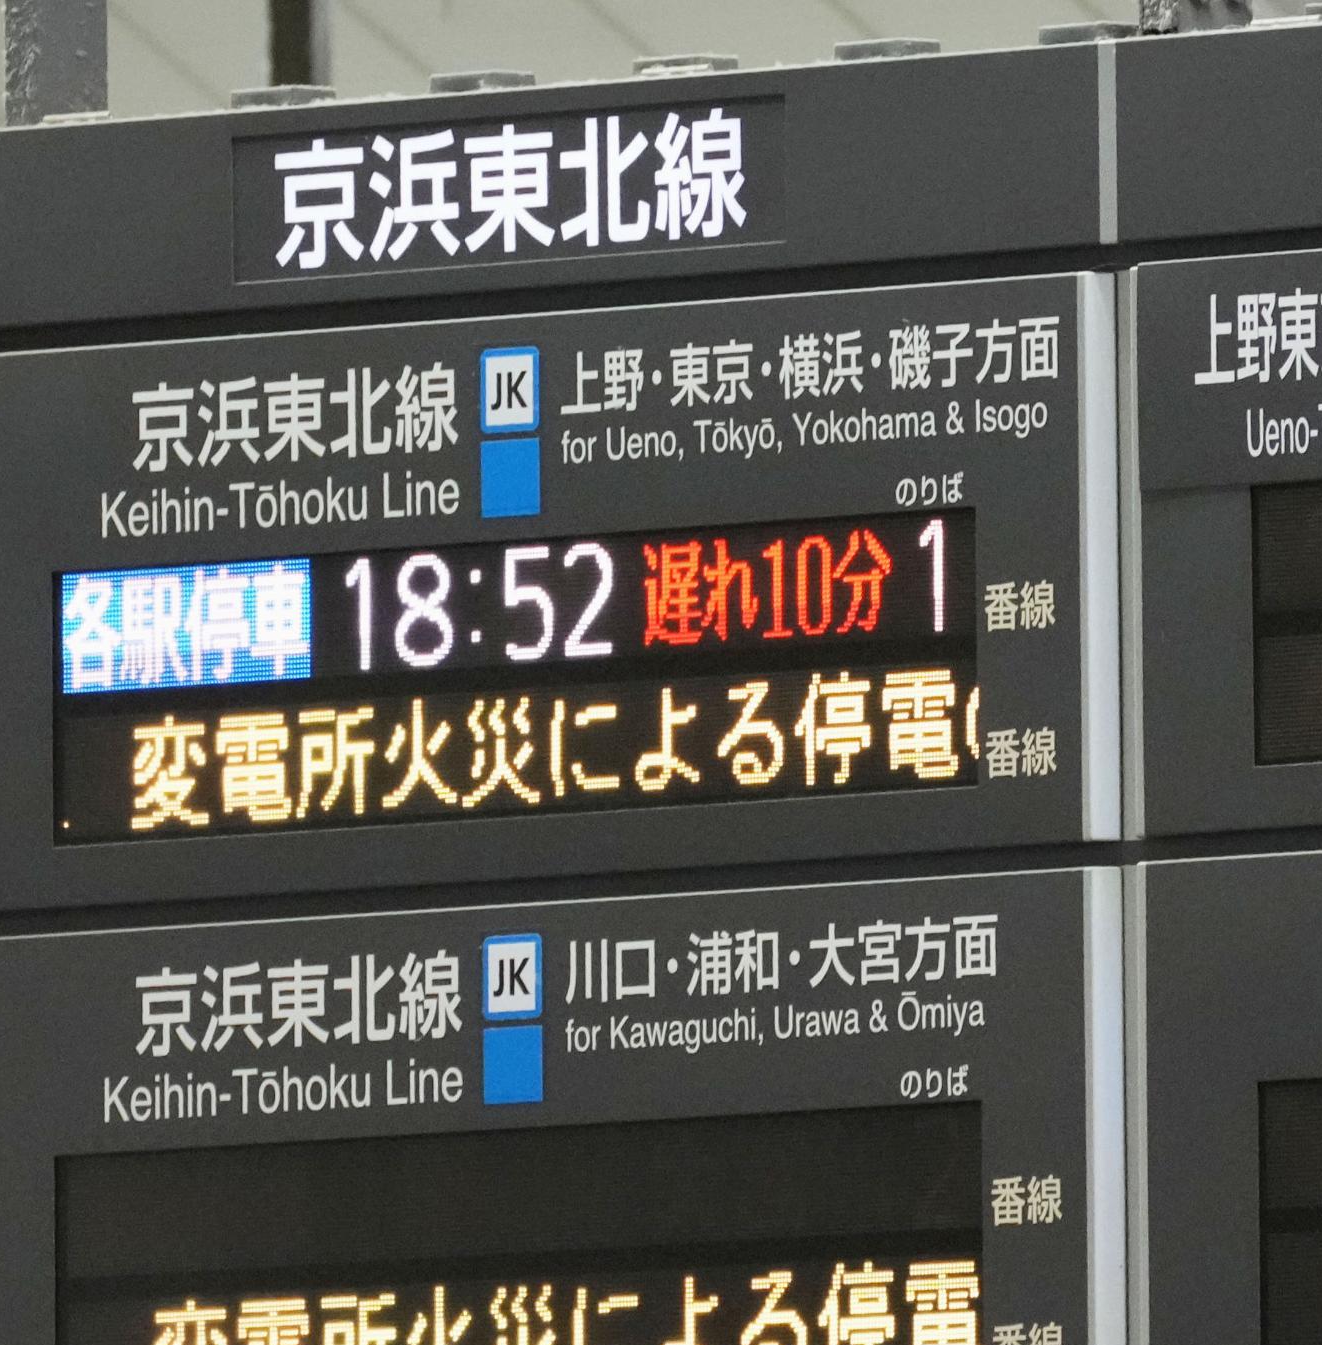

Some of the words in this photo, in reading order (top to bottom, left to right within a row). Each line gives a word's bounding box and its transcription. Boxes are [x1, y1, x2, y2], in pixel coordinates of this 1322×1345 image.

[273, 107, 747, 269] 京浜東北線
[491, 371, 528, 410] JK
[560, 316, 1061, 416] 上野・東京・横浜・磯子方面
[132, 361, 460, 473] 京浜東北線
[561, 429, 596, 465] for
[606, 427, 685, 463] Ueno,
[693, 416, 784, 459] Tōkyō,
[792, 404, 937, 448] Yokohama
[946, 401, 965, 435] &
[975, 398, 1048, 440] Isogo
[101, 477, 368, 539] Keihin-Tōhoku
[382, 471, 460, 519] Line
[894, 471, 964, 507] のりば
[61, 558, 311, 695] 各駅停車
[343, 542, 615, 672] 18:52
[642, 528, 892, 648] 遅れ10分
[918, 517, 947, 634] 1
[983, 579, 1057, 632] 番線
[985, 728, 1058, 780] 番線
[492, 957, 531, 998] JK
[565, 914, 999, 1005] 川口・浦和・大宮方面
[135, 949, 463, 1057] 京浜東北線
[565, 1018, 602, 1053] for
[609, 1007, 766, 1055] Kawaguchi,
[773, 1004, 860, 1040] Urawa
[869, 999, 889, 1033] &
[896, 991, 986, 1038] Ōmiya
[103, 1064, 371, 1124] Keihin-Tōhoku
[385, 1059, 464, 1107] Line
[899, 1064, 970, 1099] のりば
[989, 1174, 1064, 1228] 番線
